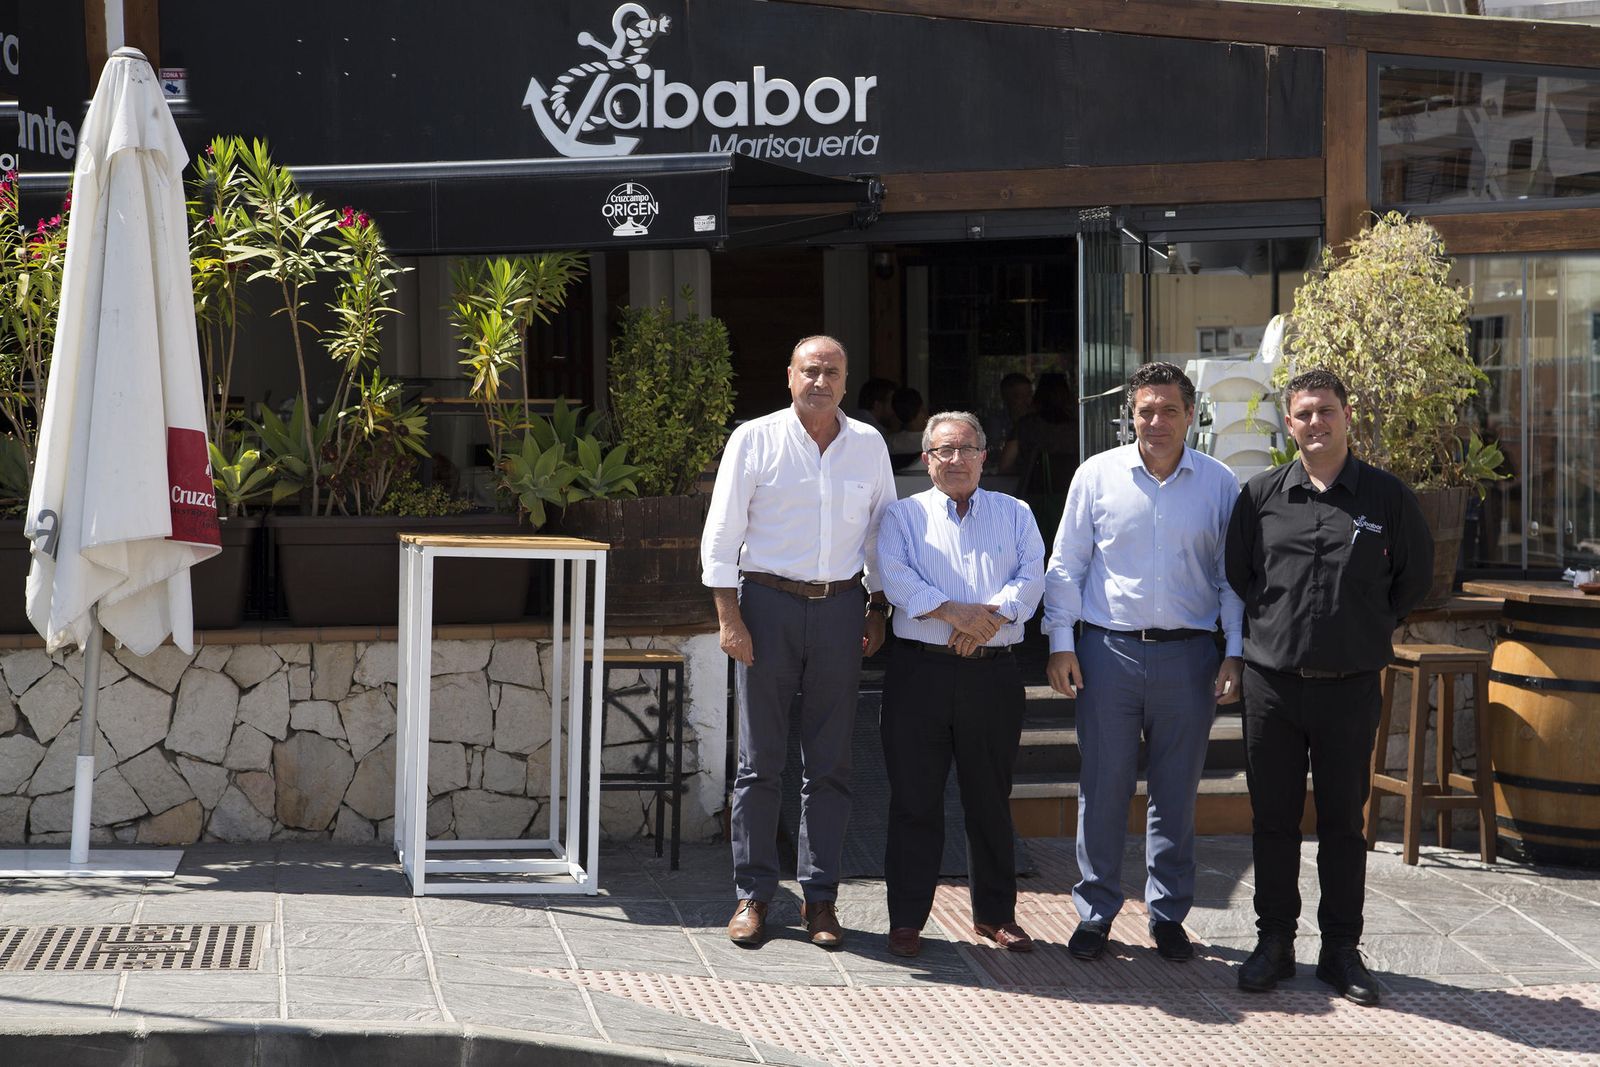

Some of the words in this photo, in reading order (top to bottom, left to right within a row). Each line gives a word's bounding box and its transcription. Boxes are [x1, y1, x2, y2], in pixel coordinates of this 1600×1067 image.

[708, 129, 880, 163] Marisquería
[610, 194, 649, 203] Cruzcampo
[602, 201, 659, 217] ORIGEN
